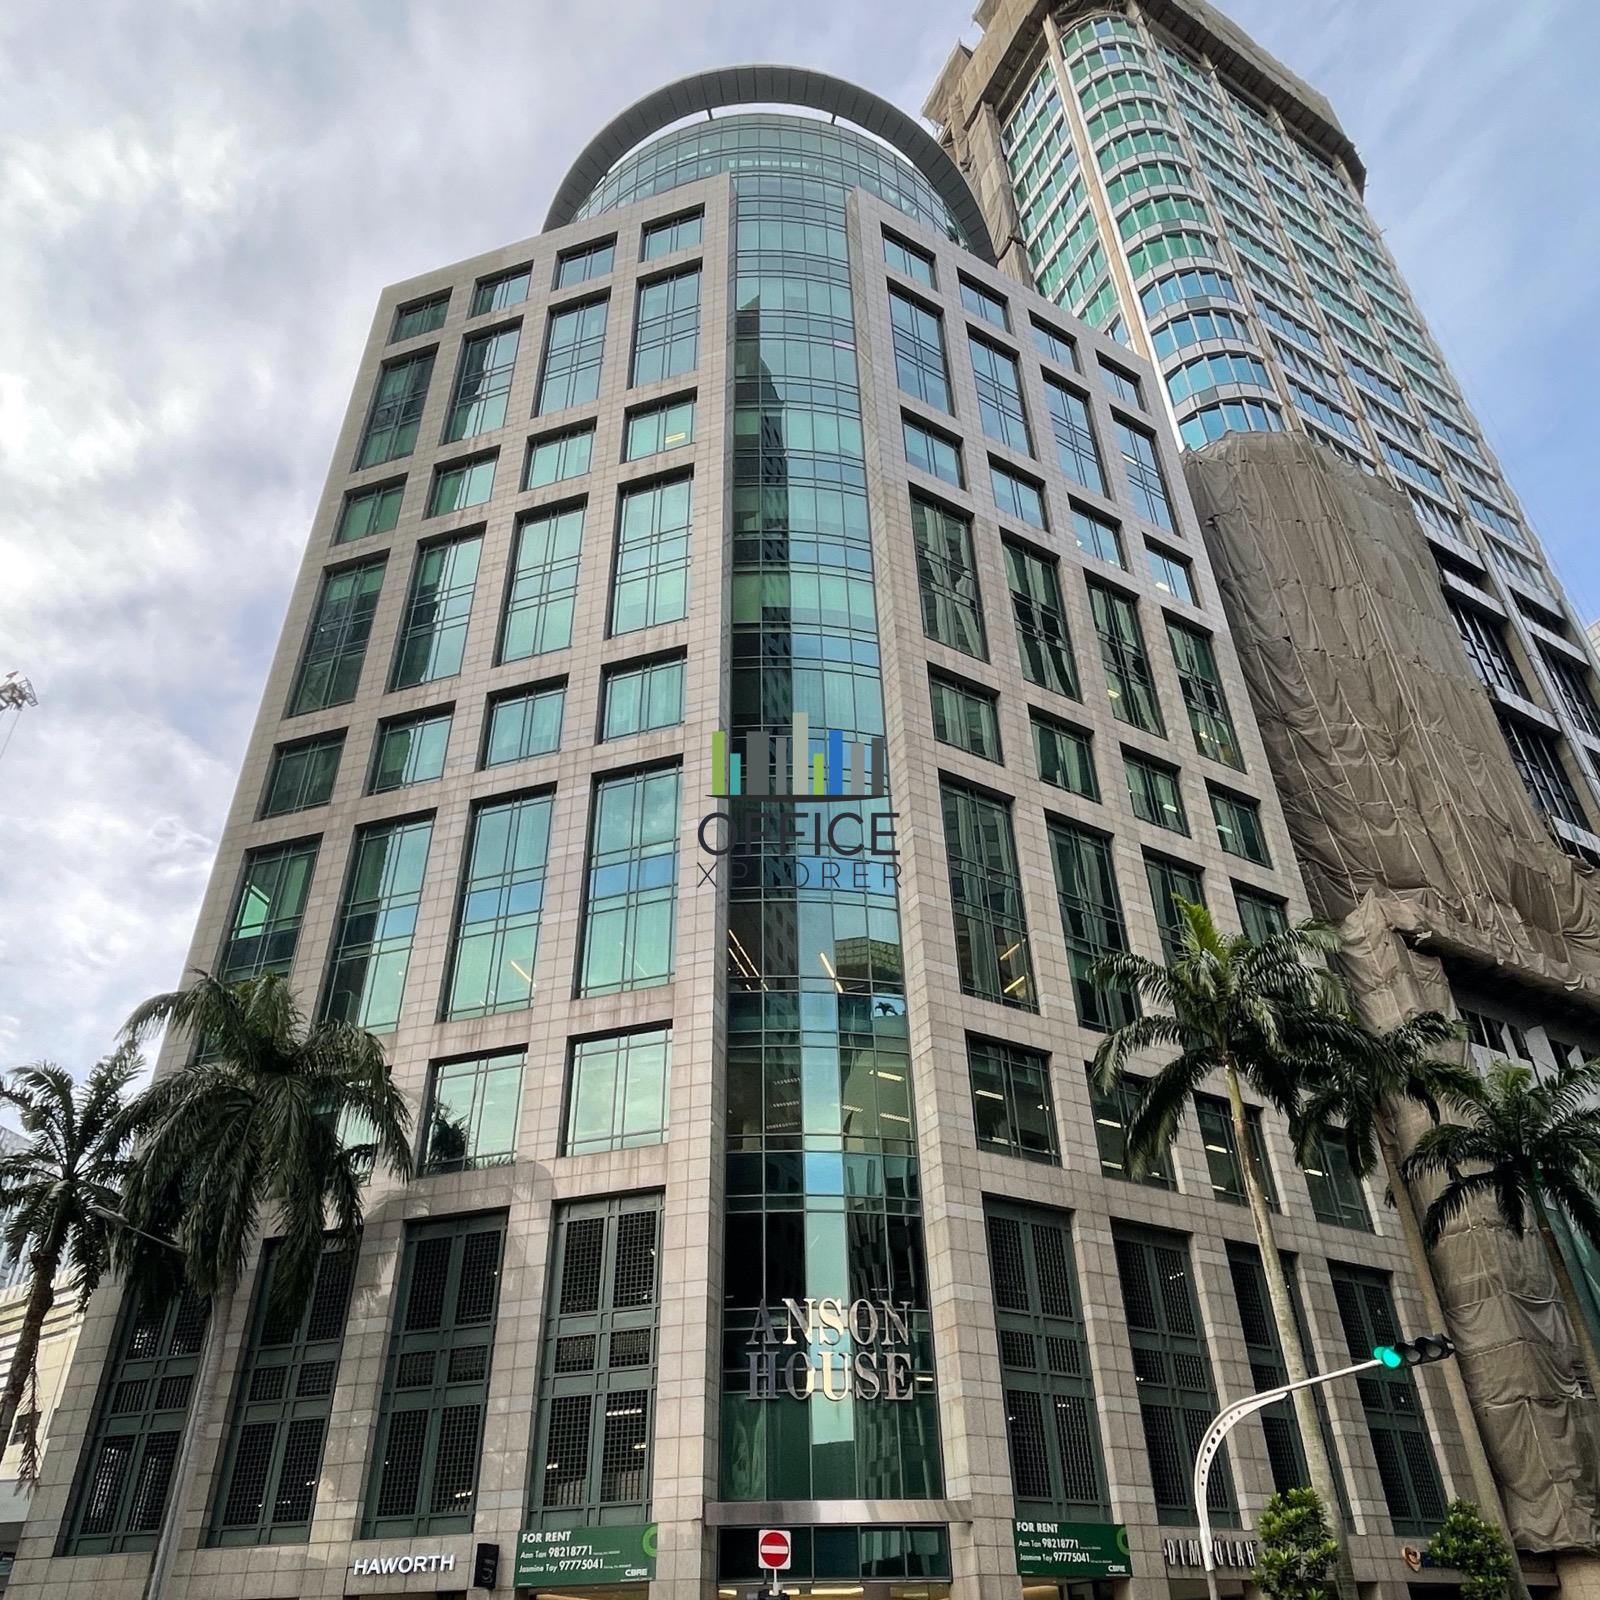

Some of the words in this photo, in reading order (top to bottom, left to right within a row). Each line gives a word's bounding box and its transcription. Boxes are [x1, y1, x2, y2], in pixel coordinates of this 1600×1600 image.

[746, 1297, 911, 1346] ANSON
[746, 1351, 914, 1401] HOUSE
[1016, 1521, 1035, 1533] FOR
[1036, 1522, 1058, 1534] RENT
[521, 1532, 543, 1544] FOR
[545, 1530, 572, 1542] RENT
[1041, 1538, 1079, 1549] 98218771
[548, 1545, 593, 1558] 98218771
[1053, 1552, 1090, 1563] 97775041
[1167, 1539, 1257, 1567] DIMULAH
[353, 1554, 456, 1576] HAWORTH
[559, 1558, 604, 1571] 97775041
[624, 1568, 648, 1576] CBRE
